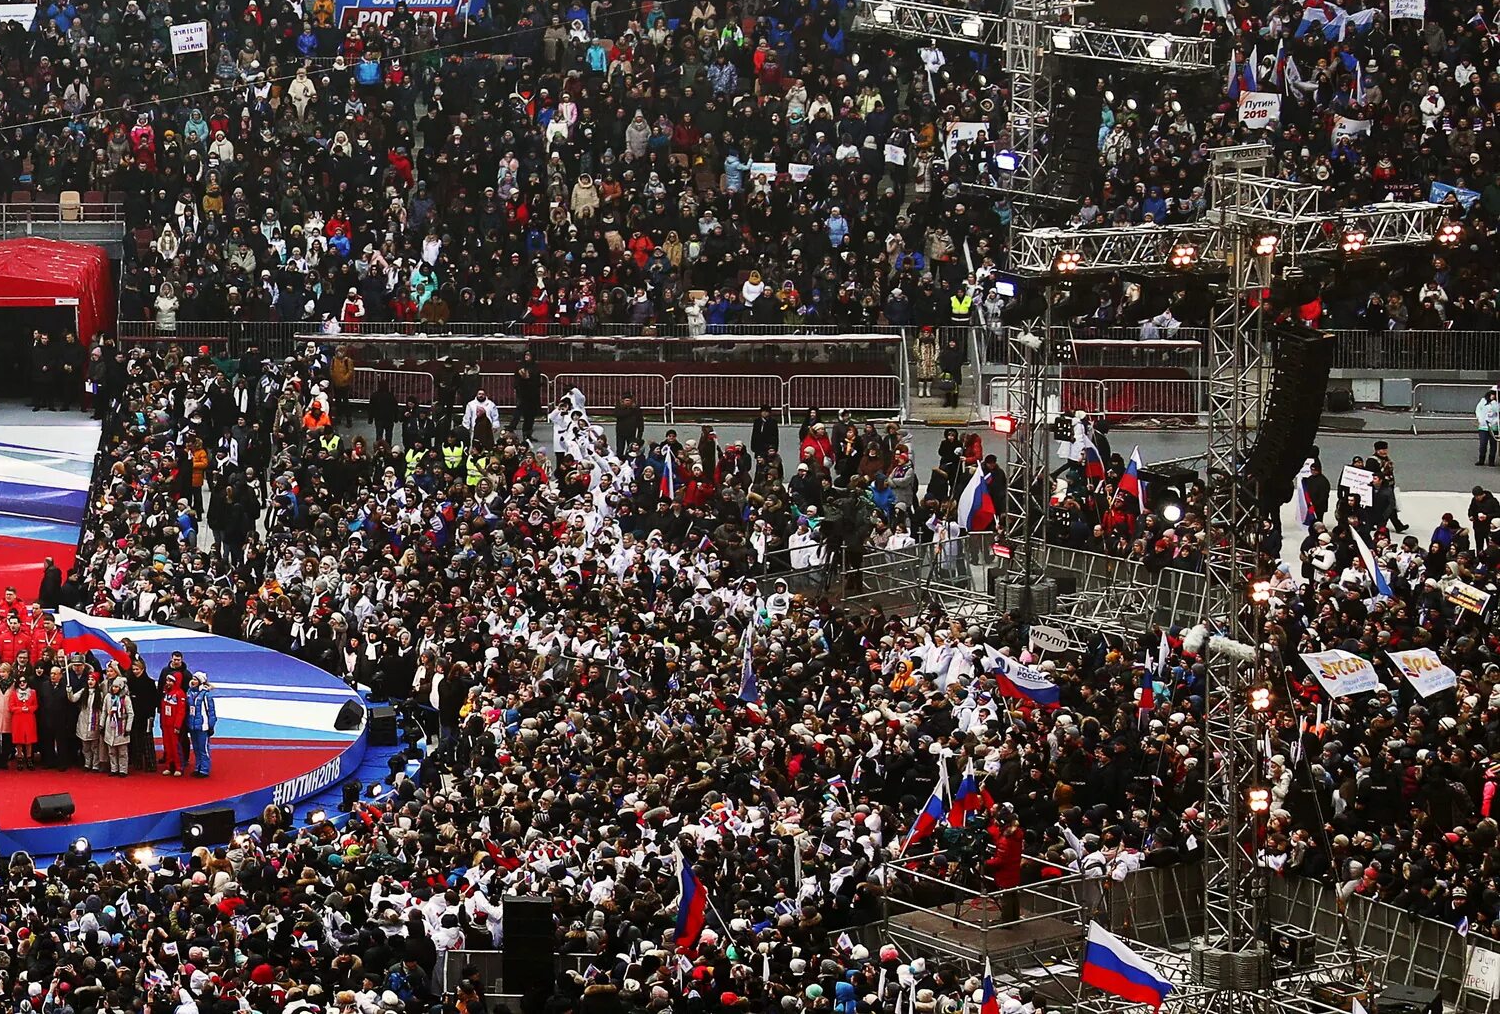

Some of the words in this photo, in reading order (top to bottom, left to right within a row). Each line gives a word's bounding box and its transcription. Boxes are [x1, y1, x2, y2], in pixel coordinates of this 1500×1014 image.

[1244, 100, 1276, 110] Путин-
[1243, 109, 1268, 119] 2018
[1030, 628, 1068, 650] МГУПП
[273, 756, 341, 806] #ПУТИН2018
